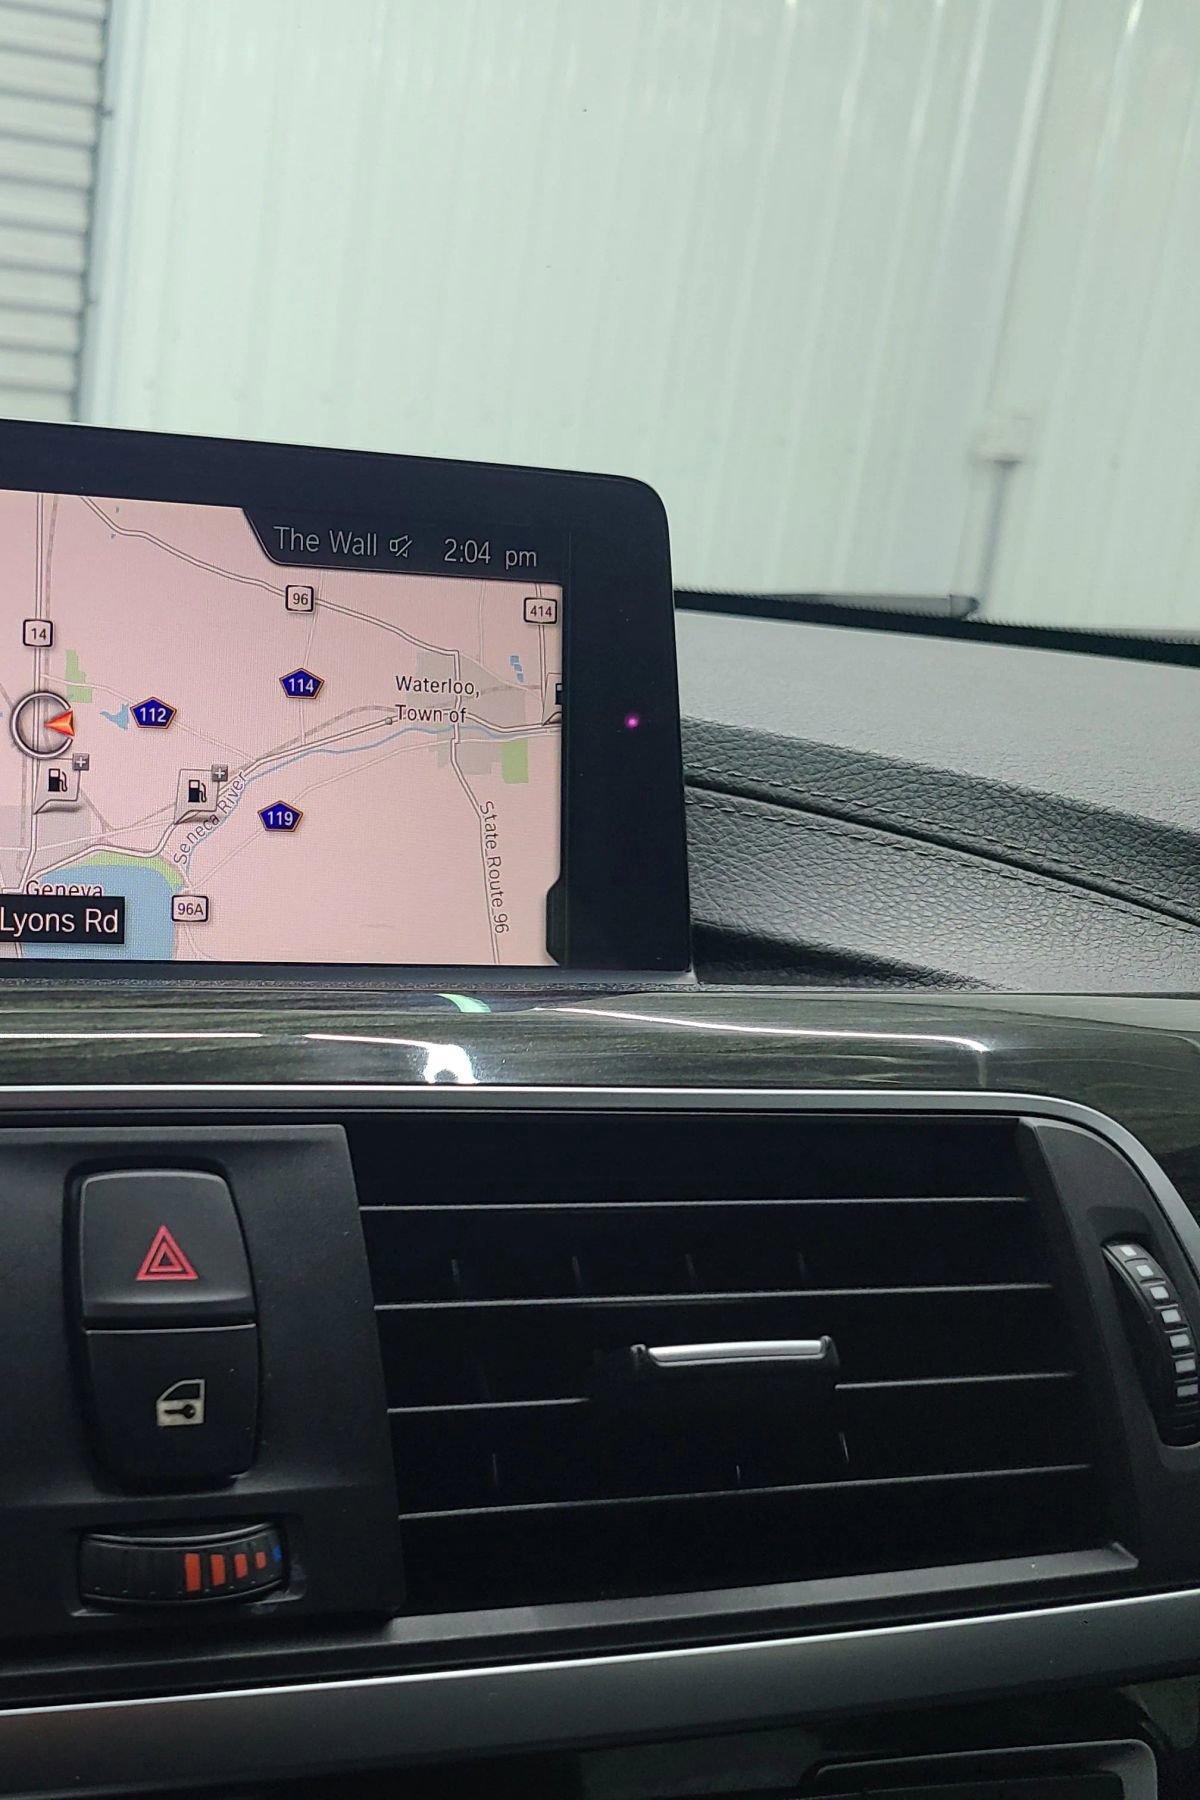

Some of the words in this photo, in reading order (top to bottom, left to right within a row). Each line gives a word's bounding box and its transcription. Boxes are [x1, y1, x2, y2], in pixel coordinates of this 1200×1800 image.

[273, 526, 320, 552] The
[329, 529, 377, 557] Wall
[443, 538, 492, 564] 2:04
[505, 549, 537, 569] pm
[292, 592, 309, 606] 96
[529, 605, 552, 619] 414
[31, 627, 47, 642] 14
[288, 678, 314, 694] 114
[395, 675, 480, 698] Waterloo,
[139, 707, 166, 723] 112
[395, 705, 442, 722] Town
[448, 707, 467, 724] of
[173, 814, 220, 865] Seneca
[217, 771, 247, 815] River
[267, 810, 294, 826] 119
[480, 800, 498, 850] State
[487, 856, 504, 908] Route
[177, 903, 204, 916] 96A
[0, 907, 75, 937] Lyons
[86, 908, 119, 933] Rd
[494, 913, 509, 934] 96
